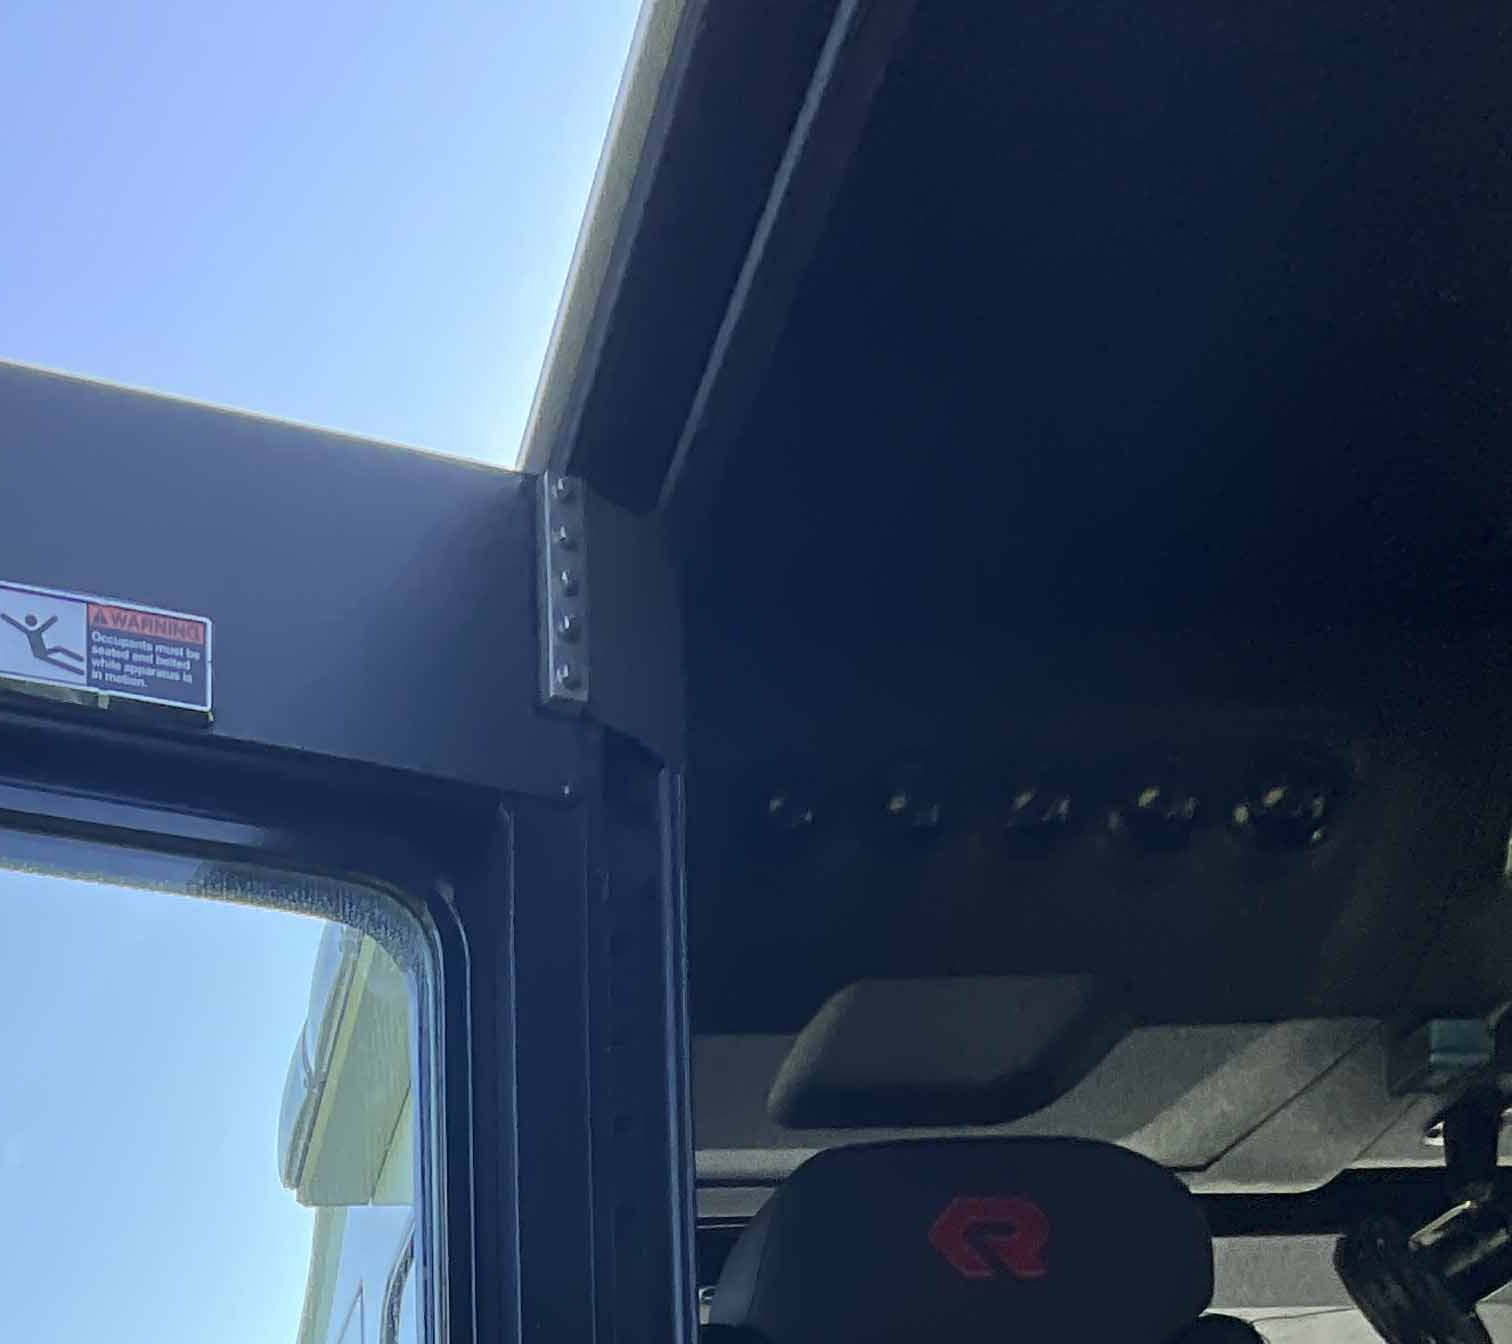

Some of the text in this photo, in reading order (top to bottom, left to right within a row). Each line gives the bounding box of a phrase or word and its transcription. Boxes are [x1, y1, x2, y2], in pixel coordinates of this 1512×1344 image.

[111, 610, 199, 640] WARNING
[91, 631, 153, 651] Occupants
[155, 644, 183, 657] must
[91, 645, 130, 659] seated
[91, 657, 122, 671] while
[91, 670, 102, 680] in
